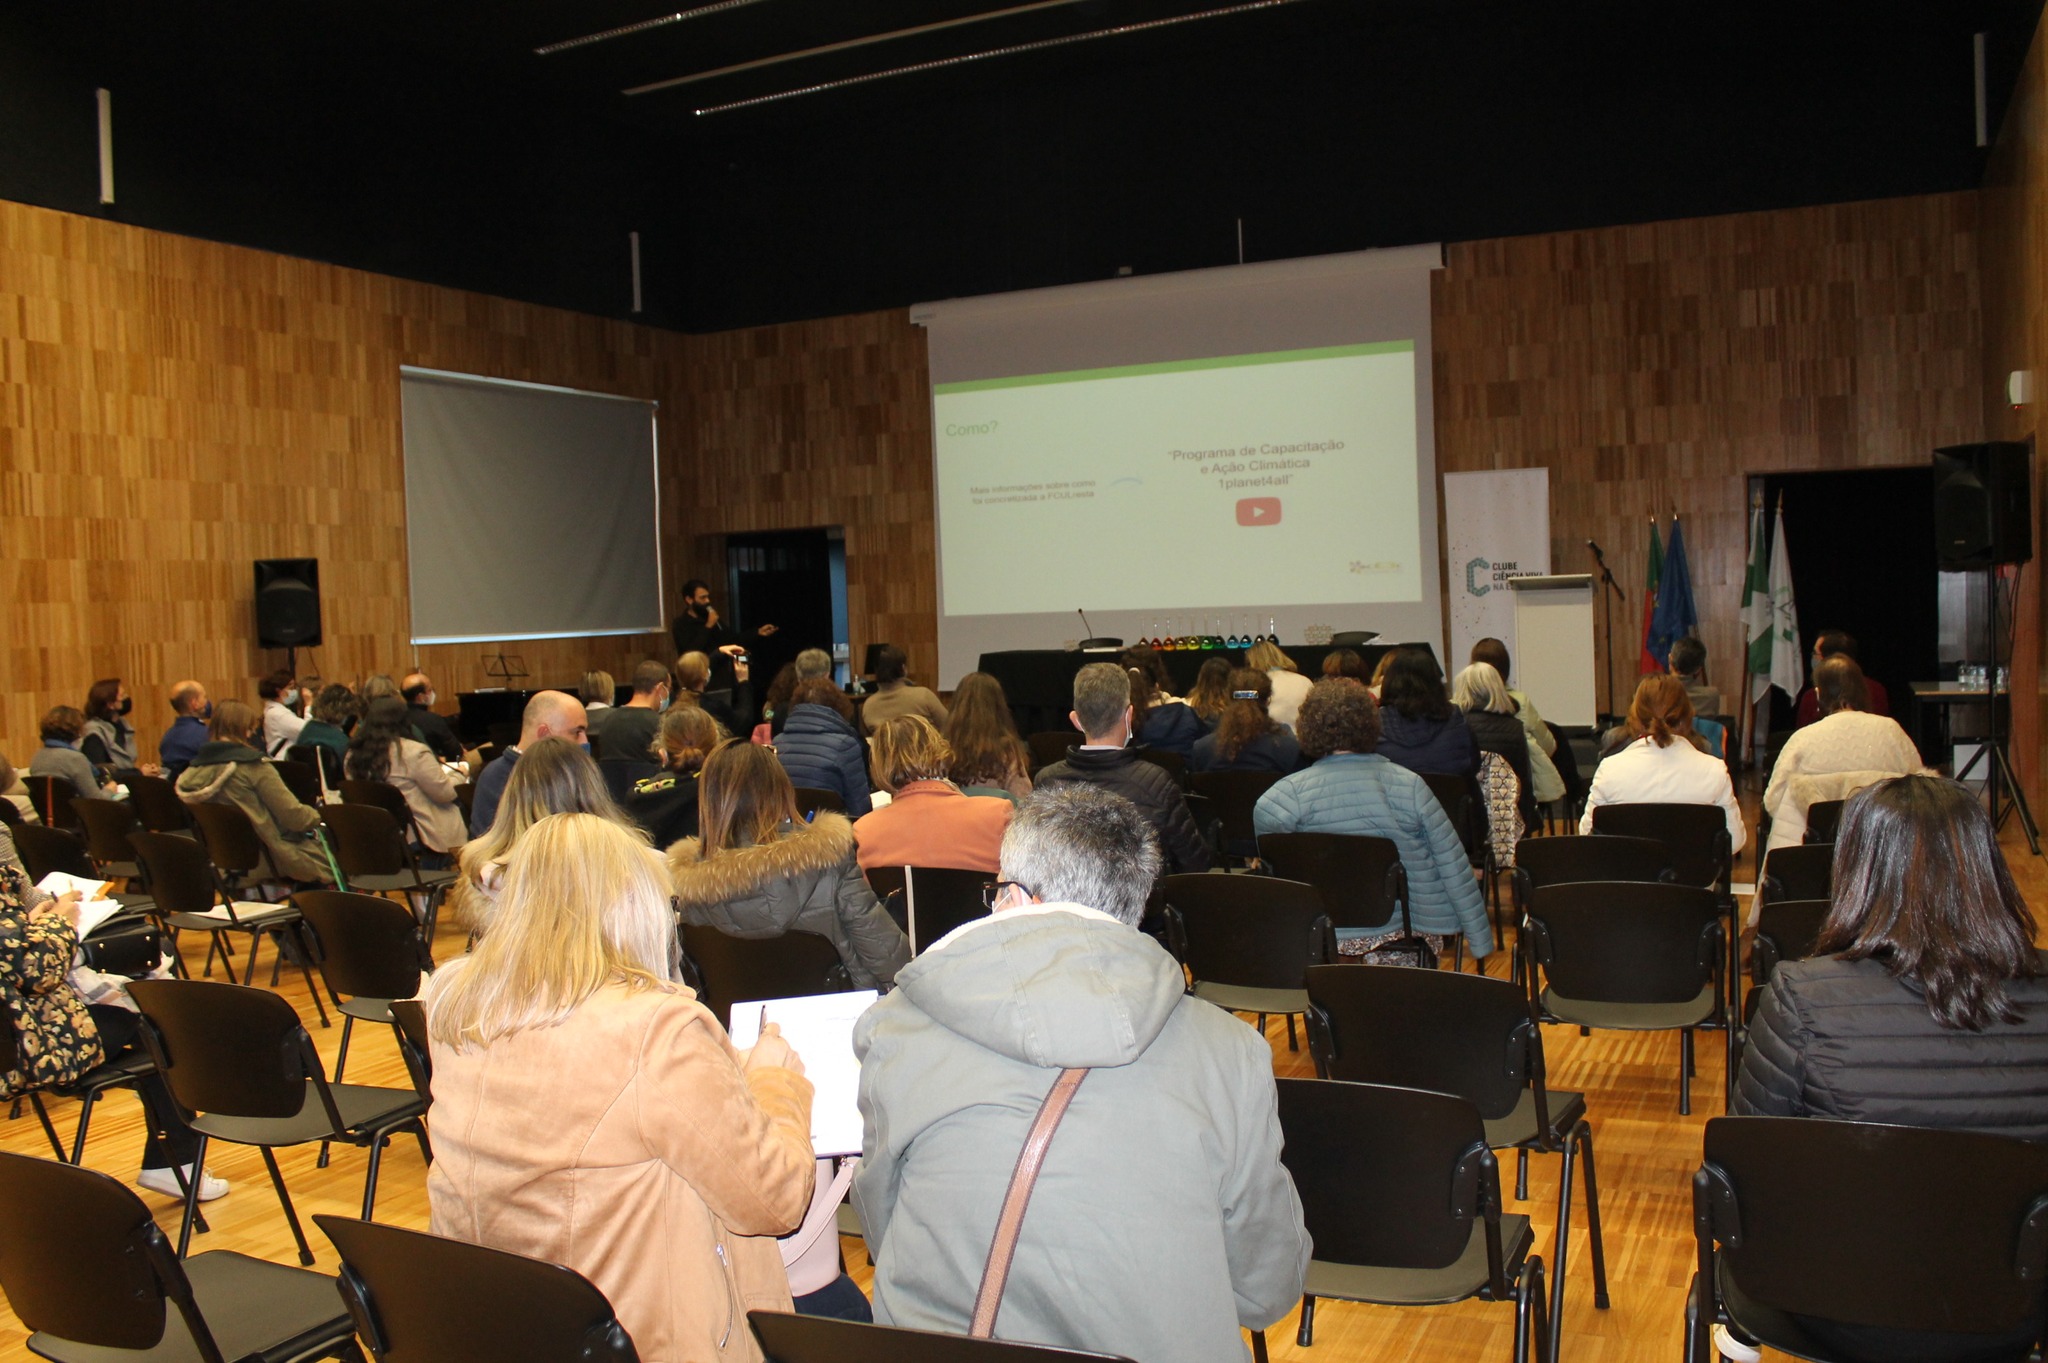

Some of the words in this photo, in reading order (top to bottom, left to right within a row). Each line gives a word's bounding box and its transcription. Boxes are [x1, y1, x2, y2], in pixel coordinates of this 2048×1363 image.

[946, 420, 998, 436] Como?
[1239, 446, 1256, 457] de
[1260, 440, 1345, 455] Capacitação
[1200, 466, 1209, 475] e
[1212, 463, 1245, 475] Ação
[1249, 458, 1311, 472] Climática
[1071, 480, 1096, 488] como
[1492, 562, 1517, 571] CLUBE
